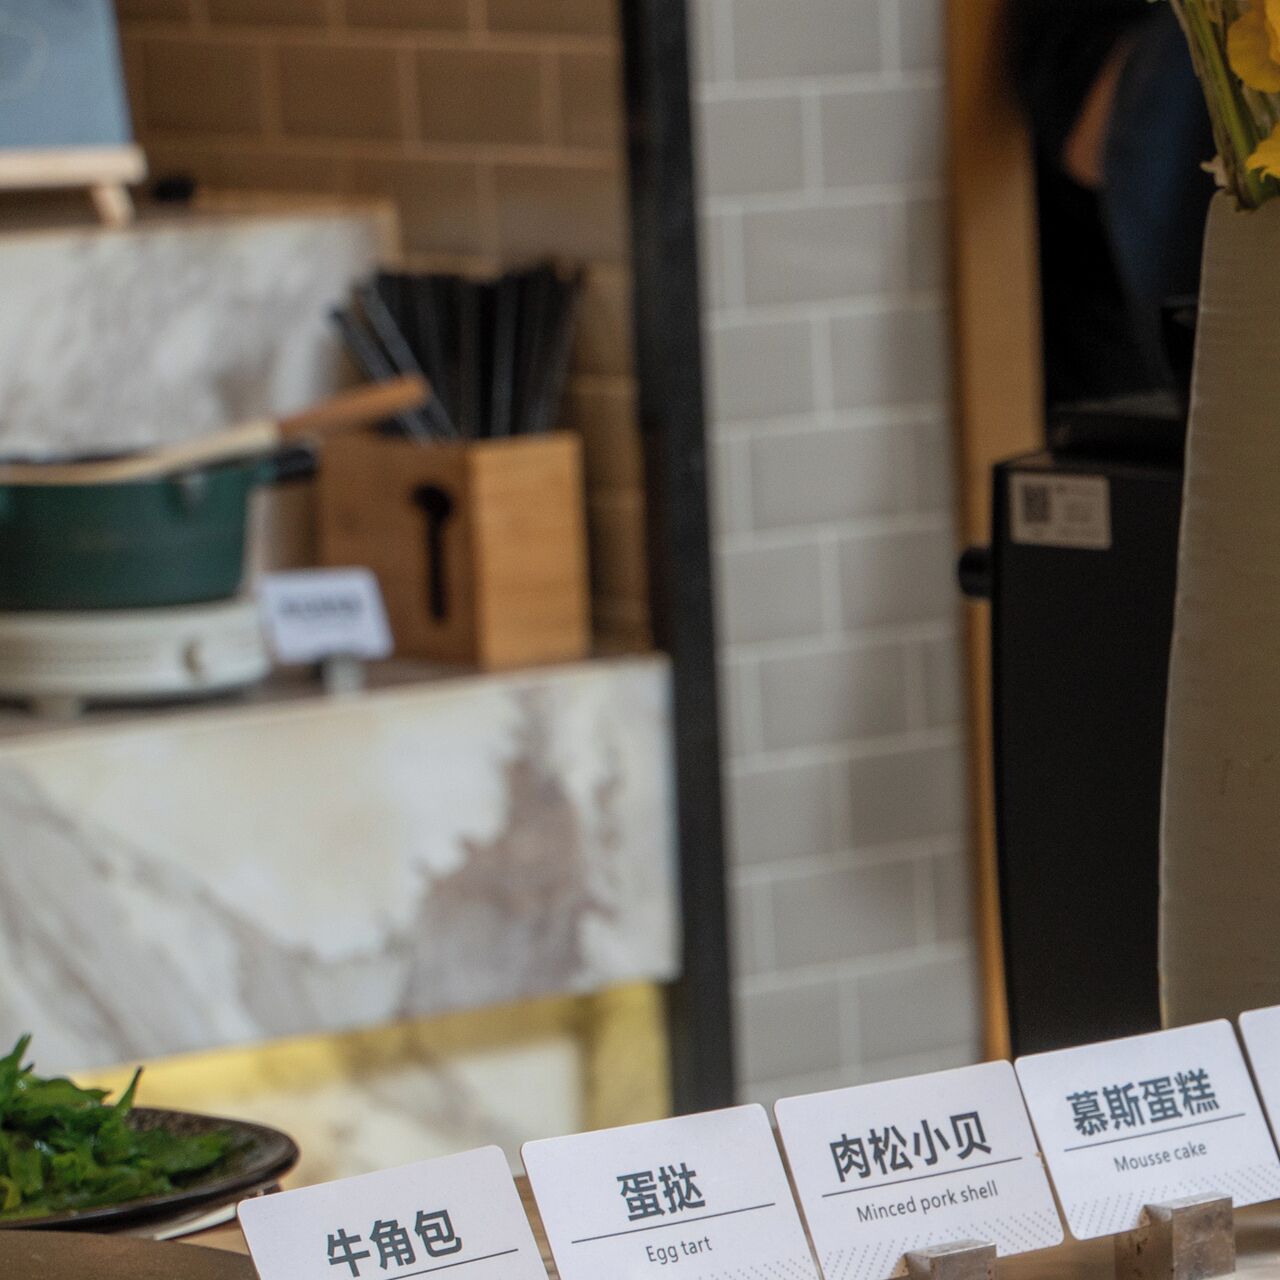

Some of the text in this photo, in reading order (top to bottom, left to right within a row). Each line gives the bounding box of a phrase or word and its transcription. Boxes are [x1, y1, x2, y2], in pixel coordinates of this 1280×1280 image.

[1065, 1067, 1221, 1138] 慕斯蛋糕
[829, 1110, 993, 1183] 肉松小贝
[1113, 1141, 1208, 1173] Mousse cake
[616, 1163, 707, 1223] 蛋挞
[856, 1179, 999, 1223] Minced pork shell
[325, 1208, 464, 1279] 牛角包
[645, 1235, 714, 1266] Egg tart
